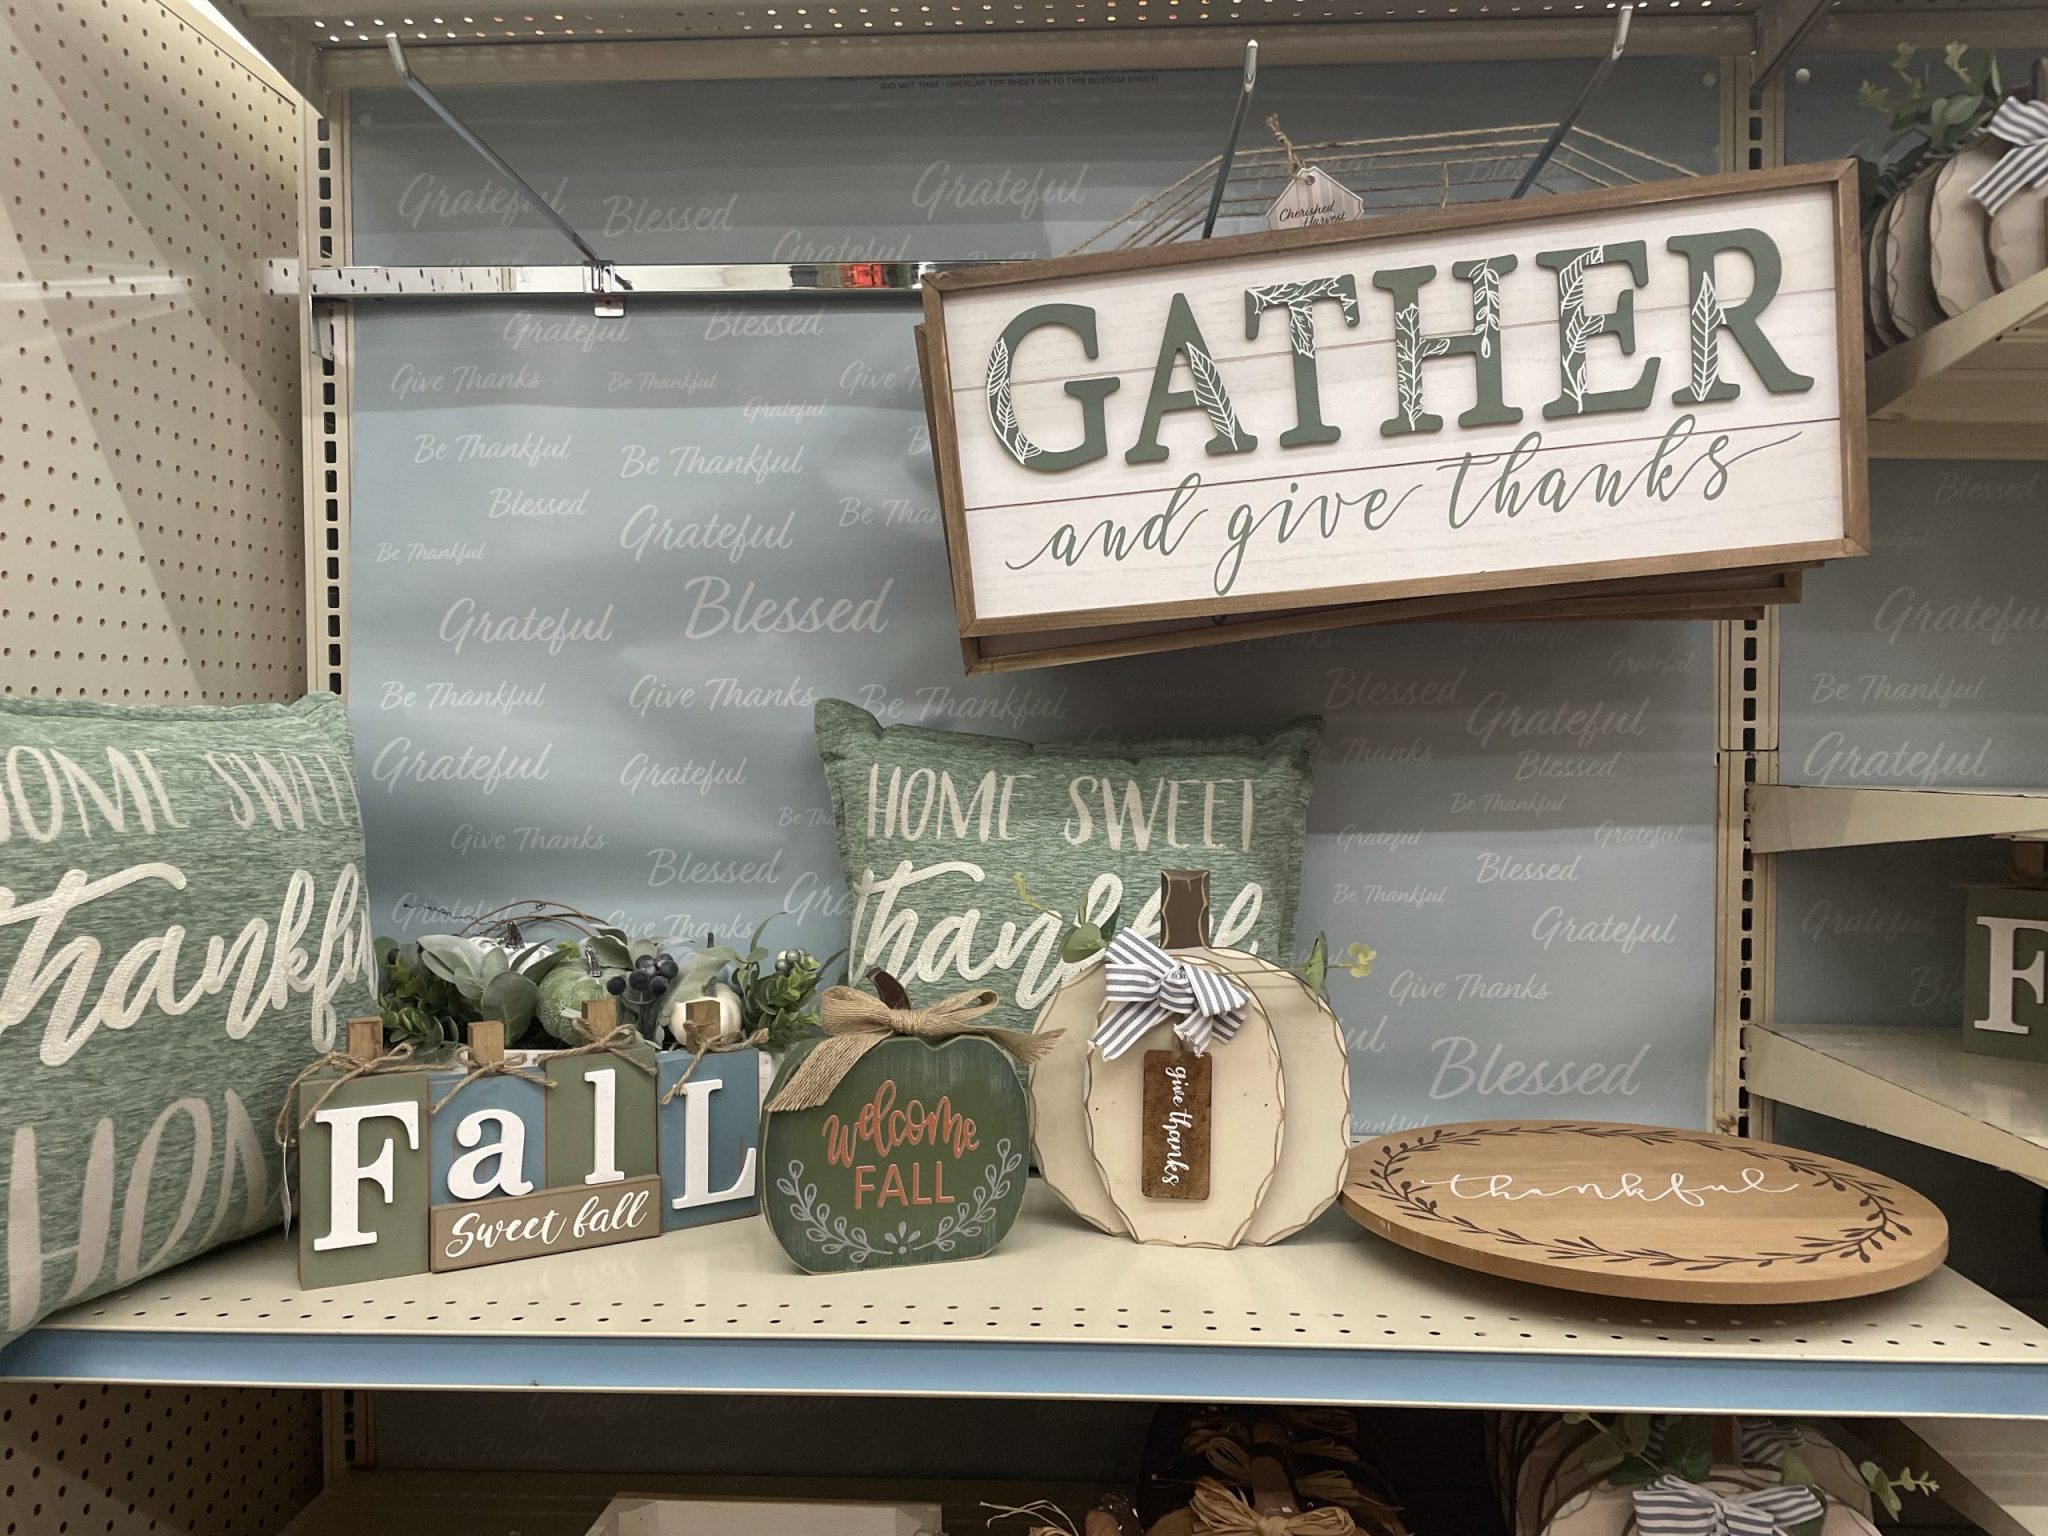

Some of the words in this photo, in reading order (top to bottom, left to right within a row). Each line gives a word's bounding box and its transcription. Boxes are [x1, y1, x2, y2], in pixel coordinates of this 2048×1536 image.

[897, 81, 915, 90] NOT
[918, 80, 939, 89] TRIM
[946, 79, 986, 88] OVERLAP
[988, 79, 1005, 87] TOP
[1008, 78, 1035, 87] SHEET
[1088, 75, 1126, 85] BOTTOM
[912, 160, 1090, 221] Grateful
[603, 193, 740, 238] Blessed
[1280, 201, 1335, 221] Cherished
[503, 310, 631, 352] Grateful
[704, 303, 824, 341] Blessed
[986, 228, 1814, 473] GATHER
[391, 363, 446, 399] Give
[452, 362, 545, 394] Thanks
[607, 370, 632, 393] Be
[638, 371, 719, 396] Thankful
[839, 359, 896, 397] Give
[743, 396, 829, 424] Grateful
[414, 433, 448, 463] Be
[455, 432, 572, 467] Thankful
[620, 444, 661, 479] Be
[670, 442, 804, 485] Thankful
[488, 487, 591, 519] Blessed
[838, 497, 873, 527] Be
[1006, 472, 1208, 570] and
[1214, 483, 1422, 596] give
[1436, 414, 1802, 530] thanks
[619, 504, 796, 563] Grateful
[376, 541, 401, 563] Be
[406, 541, 486, 567] Thankful
[439, 597, 614, 655] Grateful
[684, 575, 894, 639] Blessed
[1873, 586, 2048, 646] Gratefu
[1607, 649, 1694, 678] Grateful
[380, 680, 417, 711] Be
[425, 680, 546, 716] Thankful
[629, 674, 696, 718] Give
[704, 676, 818, 712] Thanks
[858, 683, 905, 719] Be
[914, 684, 1068, 730] Thankful
[1324, 666, 1469, 710] Blessed
[1812, 672, 1850, 703] Be
[1858, 672, 1987, 709] Thankful
[1465, 690, 1650, 749] Grateful
[371, 736, 552, 794] Grateful
[1342, 736, 1436, 766] Thanks
[1514, 750, 1622, 781] Blessed
[1803, 731, 1993, 785] Grateful
[619, 753, 748, 796] Grateful
[778, 806, 801, 828] Be
[868, 763, 1036, 842] HOME
[1064, 775, 1262, 852] SWEET
[1450, 792, 1475, 814] Be
[1482, 792, 1566, 818] Thankful
[450, 824, 505, 856] Give
[513, 825, 609, 852] Thanks
[1337, 823, 1425, 852] Grateful
[1593, 821, 1683, 849] Grateful
[646, 848, 784, 888] Blessed
[1476, 851, 1582, 884] Blessed
[1333, 883, 1358, 905] Be
[1363, 883, 1448, 909] Thankful
[664, 912, 756, 939] Thanks
[1530, 905, 1678, 954] Grateful
[1802, 899, 1938, 943] Grateful
[1388, 969, 1447, 1006] Give
[1454, 972, 1553, 1001] Thanks
[1976, 915, 2048, 1034] F
[1165, 1066, 1189, 1107] give
[1428, 1036, 1652, 1100] Blessed
[822, 1079, 980, 1168] welcome
[1162, 1108, 1193, 1187] thanks
[855, 1161, 955, 1210] FALL
[1420, 1168, 1799, 1207] thankful
[445, 1212, 564, 1258] Sweet
[573, 1190, 649, 1239] fall
